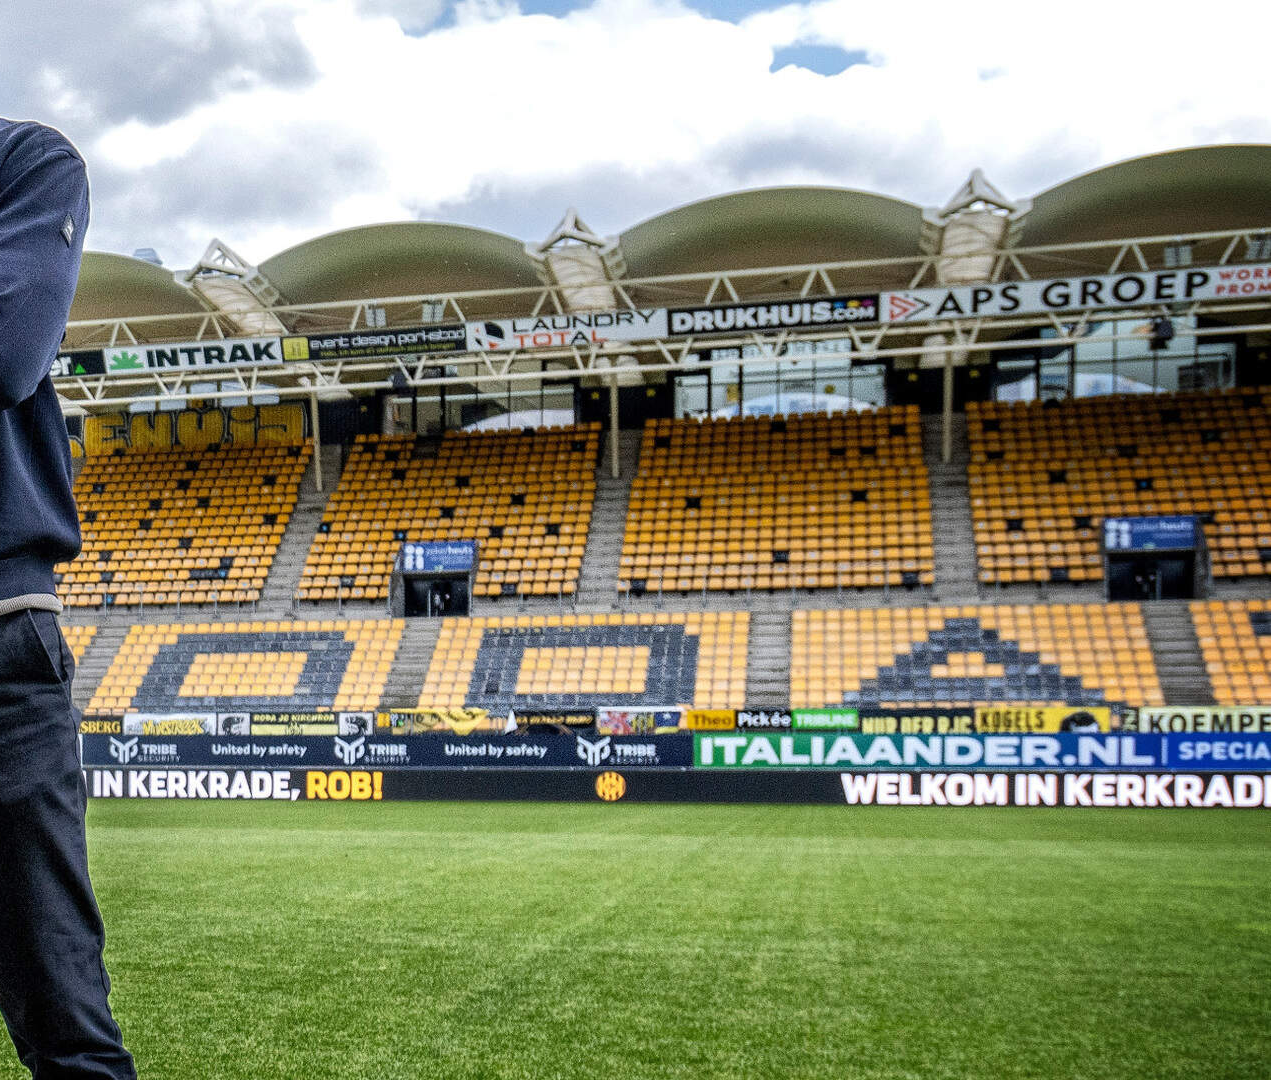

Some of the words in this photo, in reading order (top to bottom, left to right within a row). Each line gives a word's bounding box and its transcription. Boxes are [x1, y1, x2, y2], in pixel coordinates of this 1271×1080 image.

[935, 284, 1022, 317] APS
[1041, 271, 1211, 309] GROEP
[512, 311, 657, 333] LAUNDRY
[309, 336, 350, 350] event
[352, 332, 397, 348] design
[513, 329, 609, 350] TOTAL
[145, 341, 281, 368] INTRAK
[692, 713, 732, 728] Theo
[979, 710, 1045, 730] KOGELS
[141, 743, 178, 755] TRIBE
[212, 742, 251, 756] United
[252, 743, 266, 758] by
[268, 743, 308, 758] safety
[368, 743, 407, 756] TRIBE
[445, 743, 487, 757] United
[488, 743, 504, 759] by
[505, 743, 548, 759] safety
[613, 743, 657, 757] TRIBE
[700, 735, 1156, 767] ITALIAANDER.NL
[1177, 741, 1271, 761] SPECIA
[92, 769, 124, 799] IN
[128, 770, 301, 801] KERKRADE,
[306, 770, 384, 800] ROB!
[840, 772, 1008, 807] WELKOM
[1014, 773, 1058, 807] IN
[1063, 773, 1271, 808] KERKRAD
